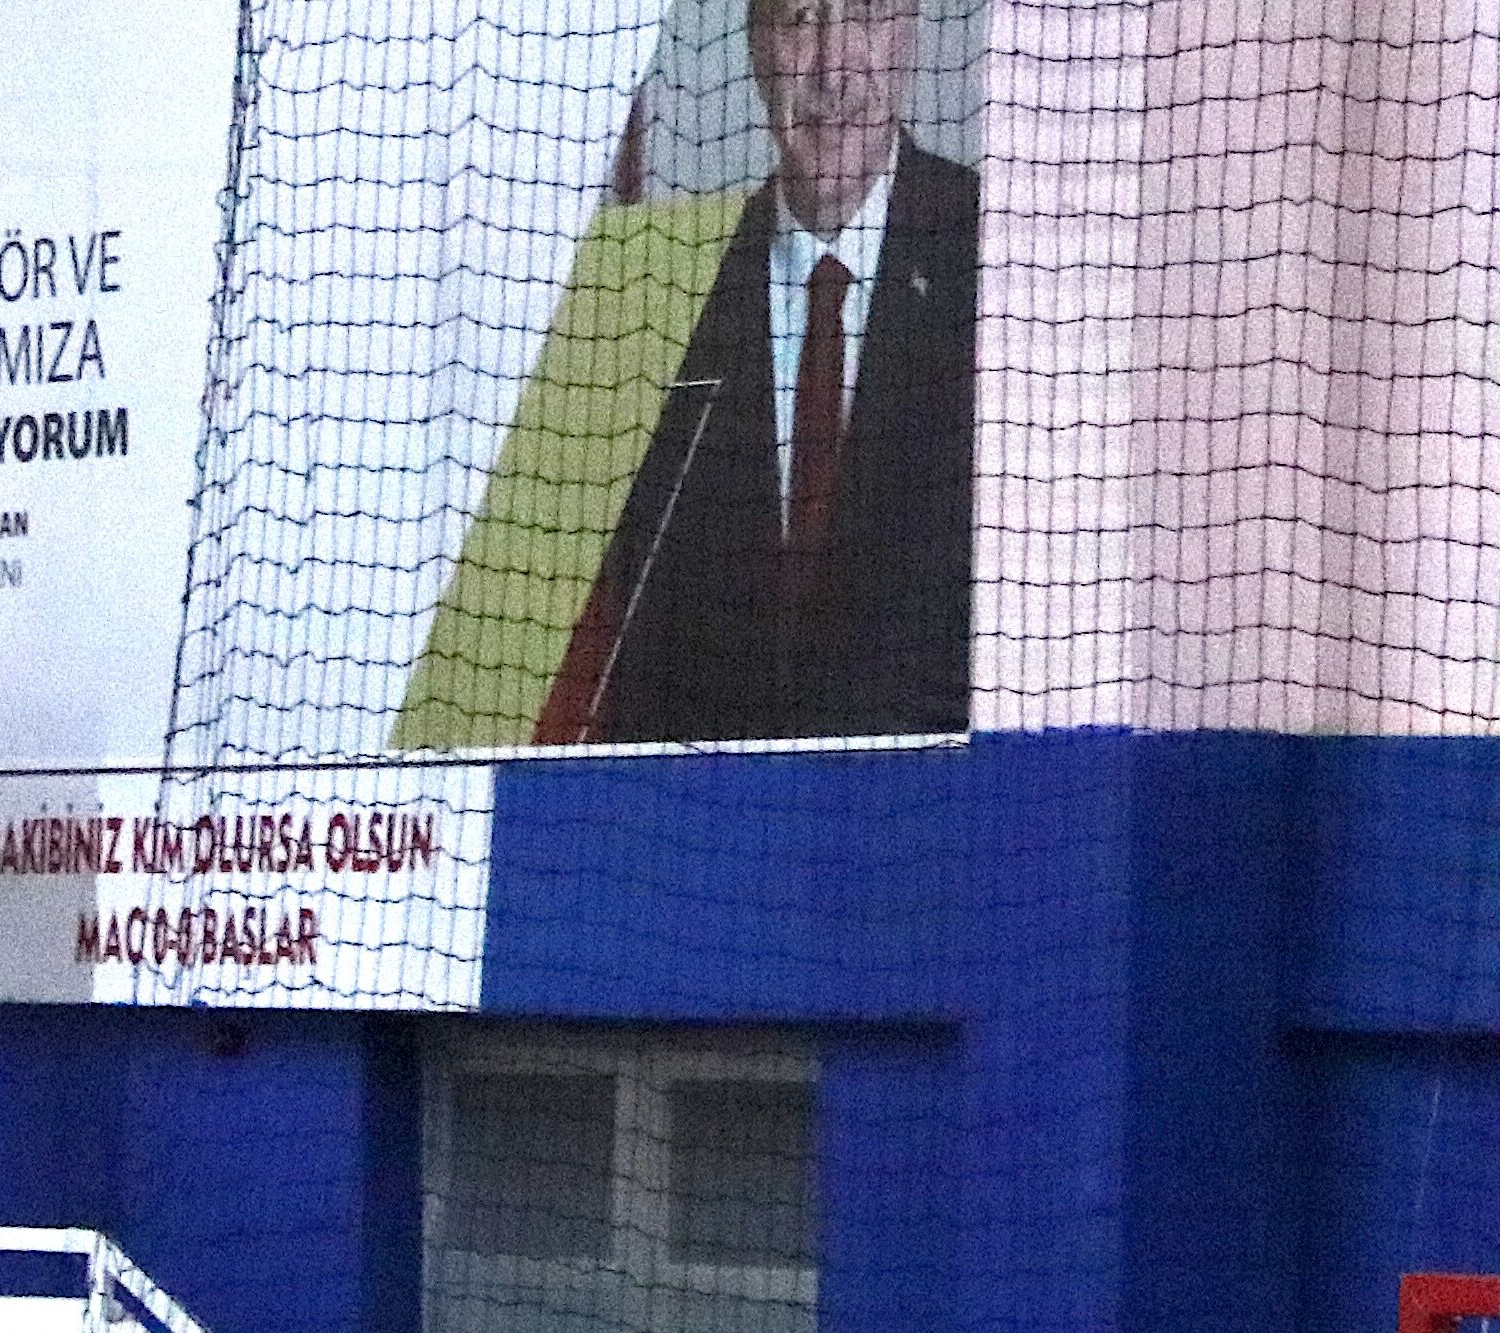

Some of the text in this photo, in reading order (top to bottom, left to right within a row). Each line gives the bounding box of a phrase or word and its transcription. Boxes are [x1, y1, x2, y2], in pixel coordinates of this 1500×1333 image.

[68, 230, 122, 296] VE
[132, 802, 185, 874] KİM
[195, 812, 315, 874] OLURSA
[325, 811, 436, 872] OLSUN
